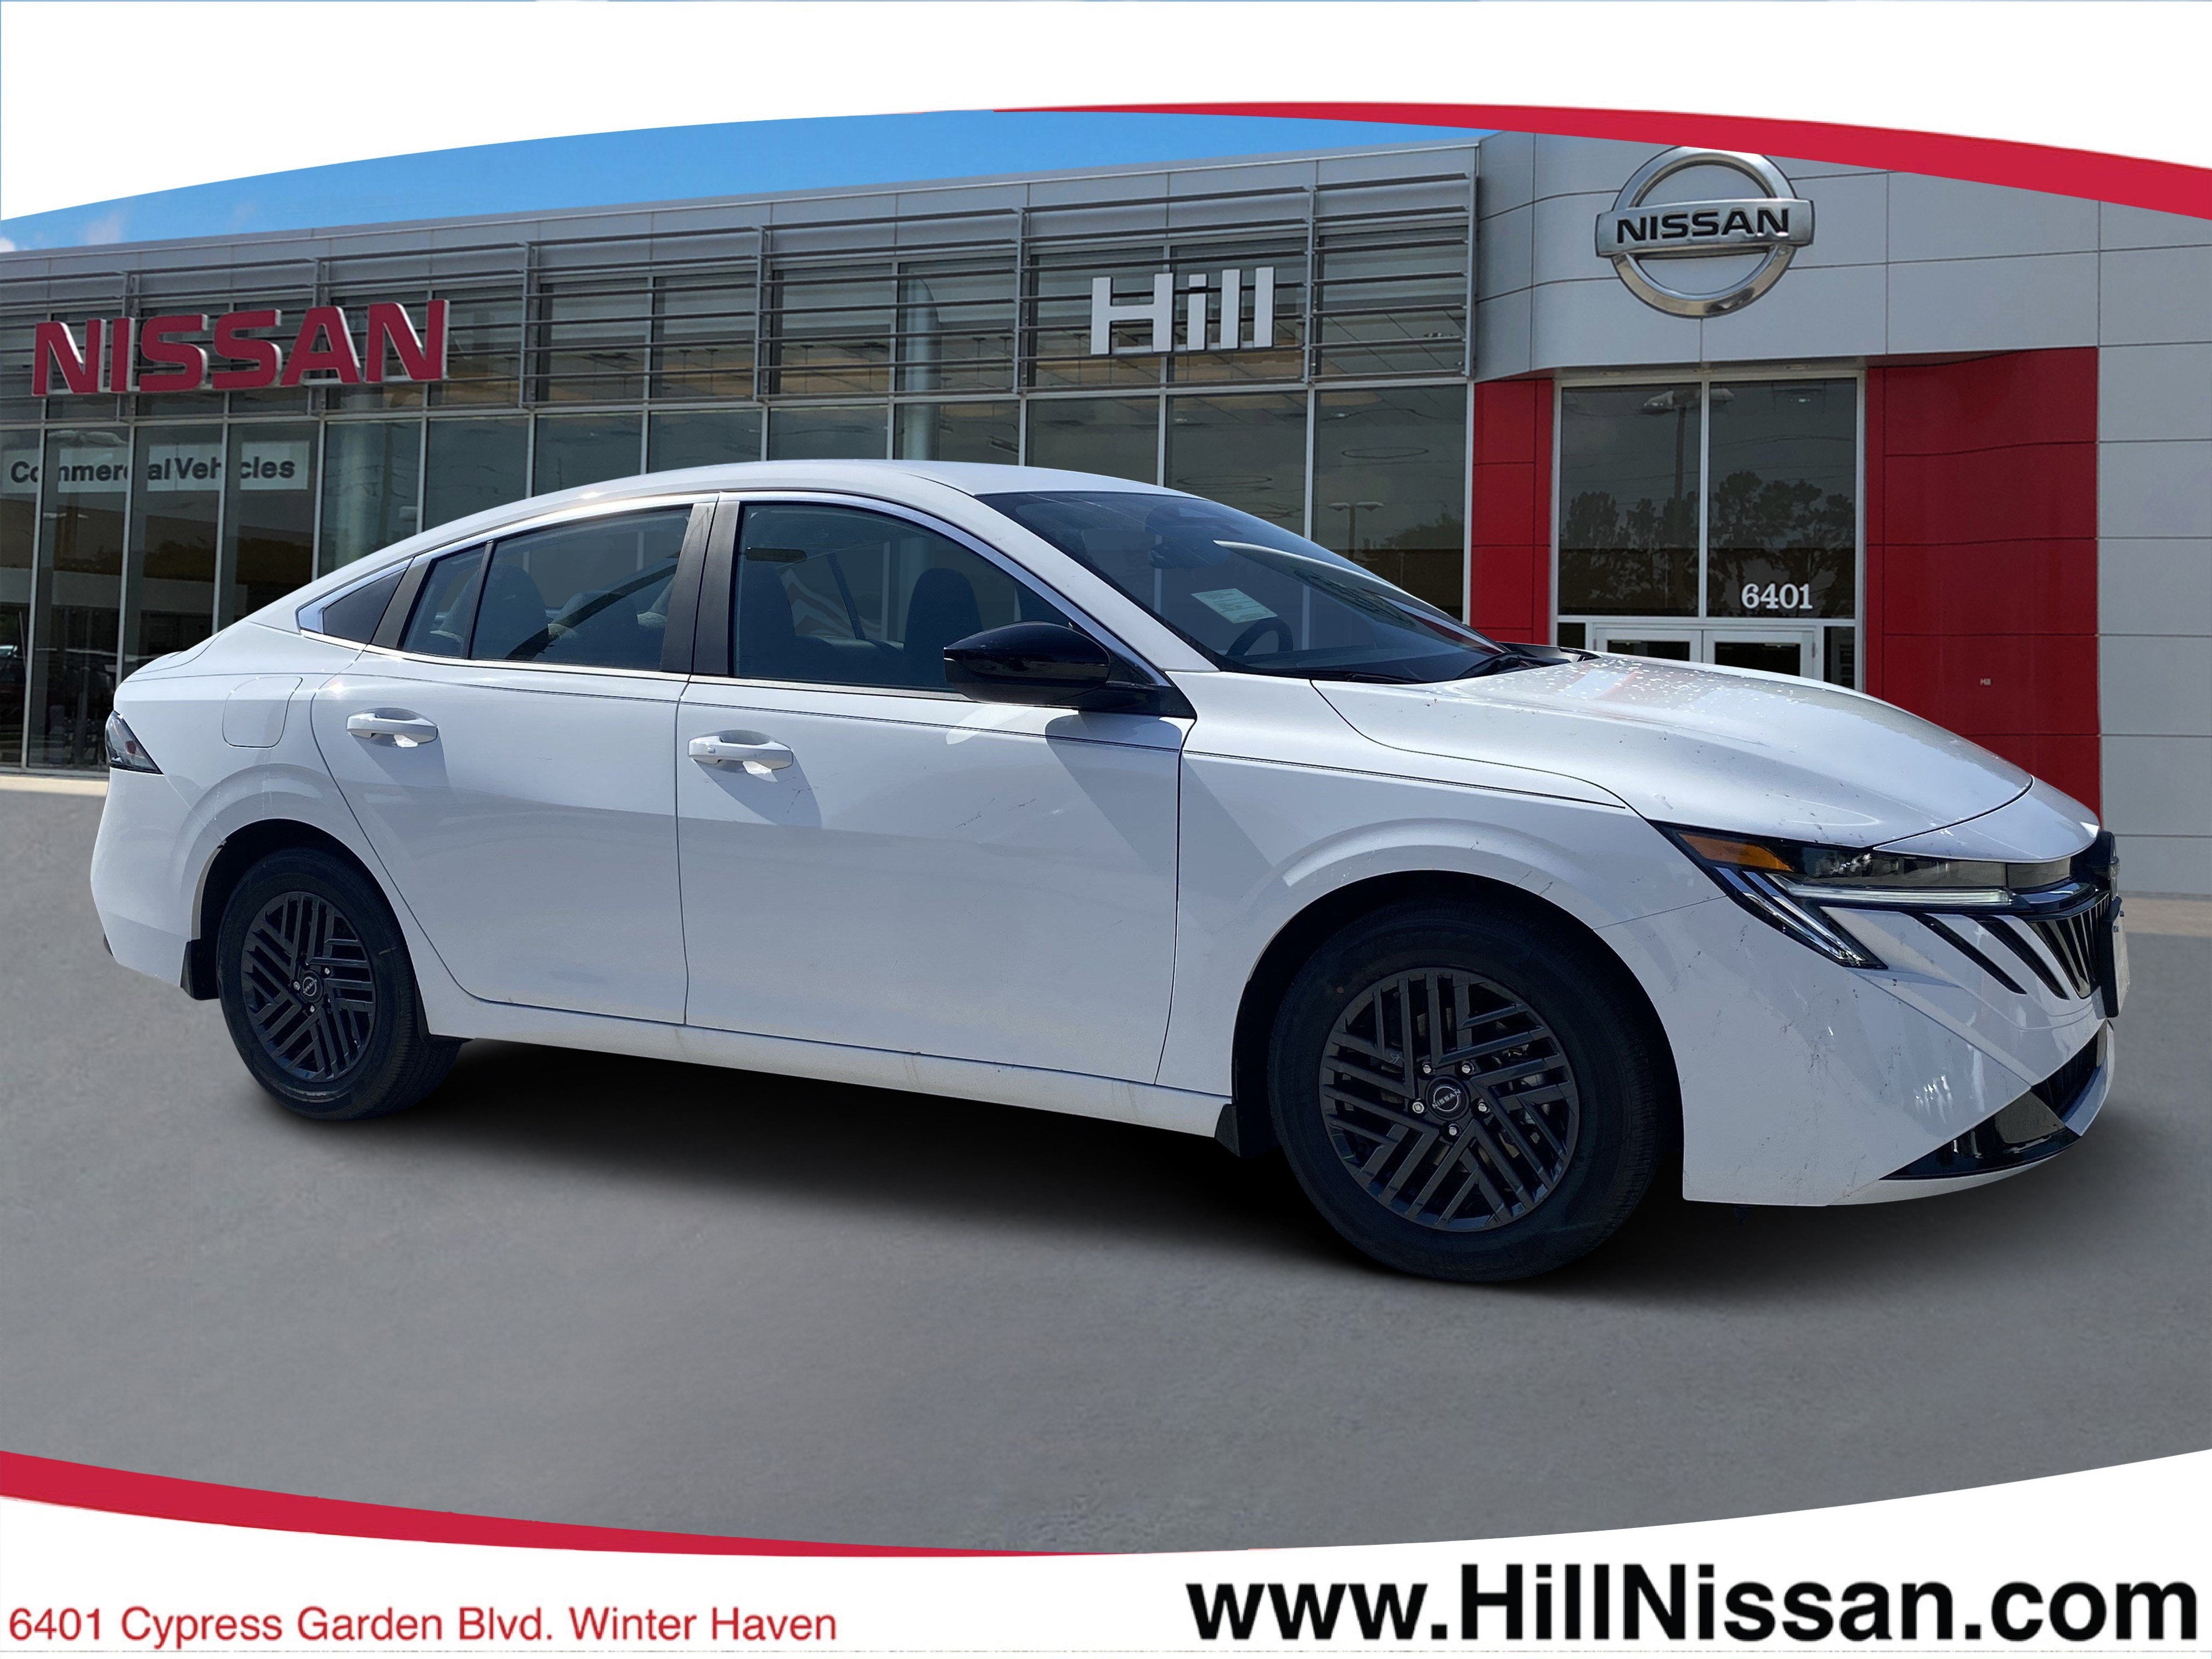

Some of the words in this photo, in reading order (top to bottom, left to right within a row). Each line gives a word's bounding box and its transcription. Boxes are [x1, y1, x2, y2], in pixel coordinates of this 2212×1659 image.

[1617, 208, 1790, 244] NISSAN
[1090, 266, 1275, 355] Hill
[32, 300, 450, 396] NISSAN
[174, 456, 295, 479] Vehcles
[1741, 583, 1813, 609] 6401
